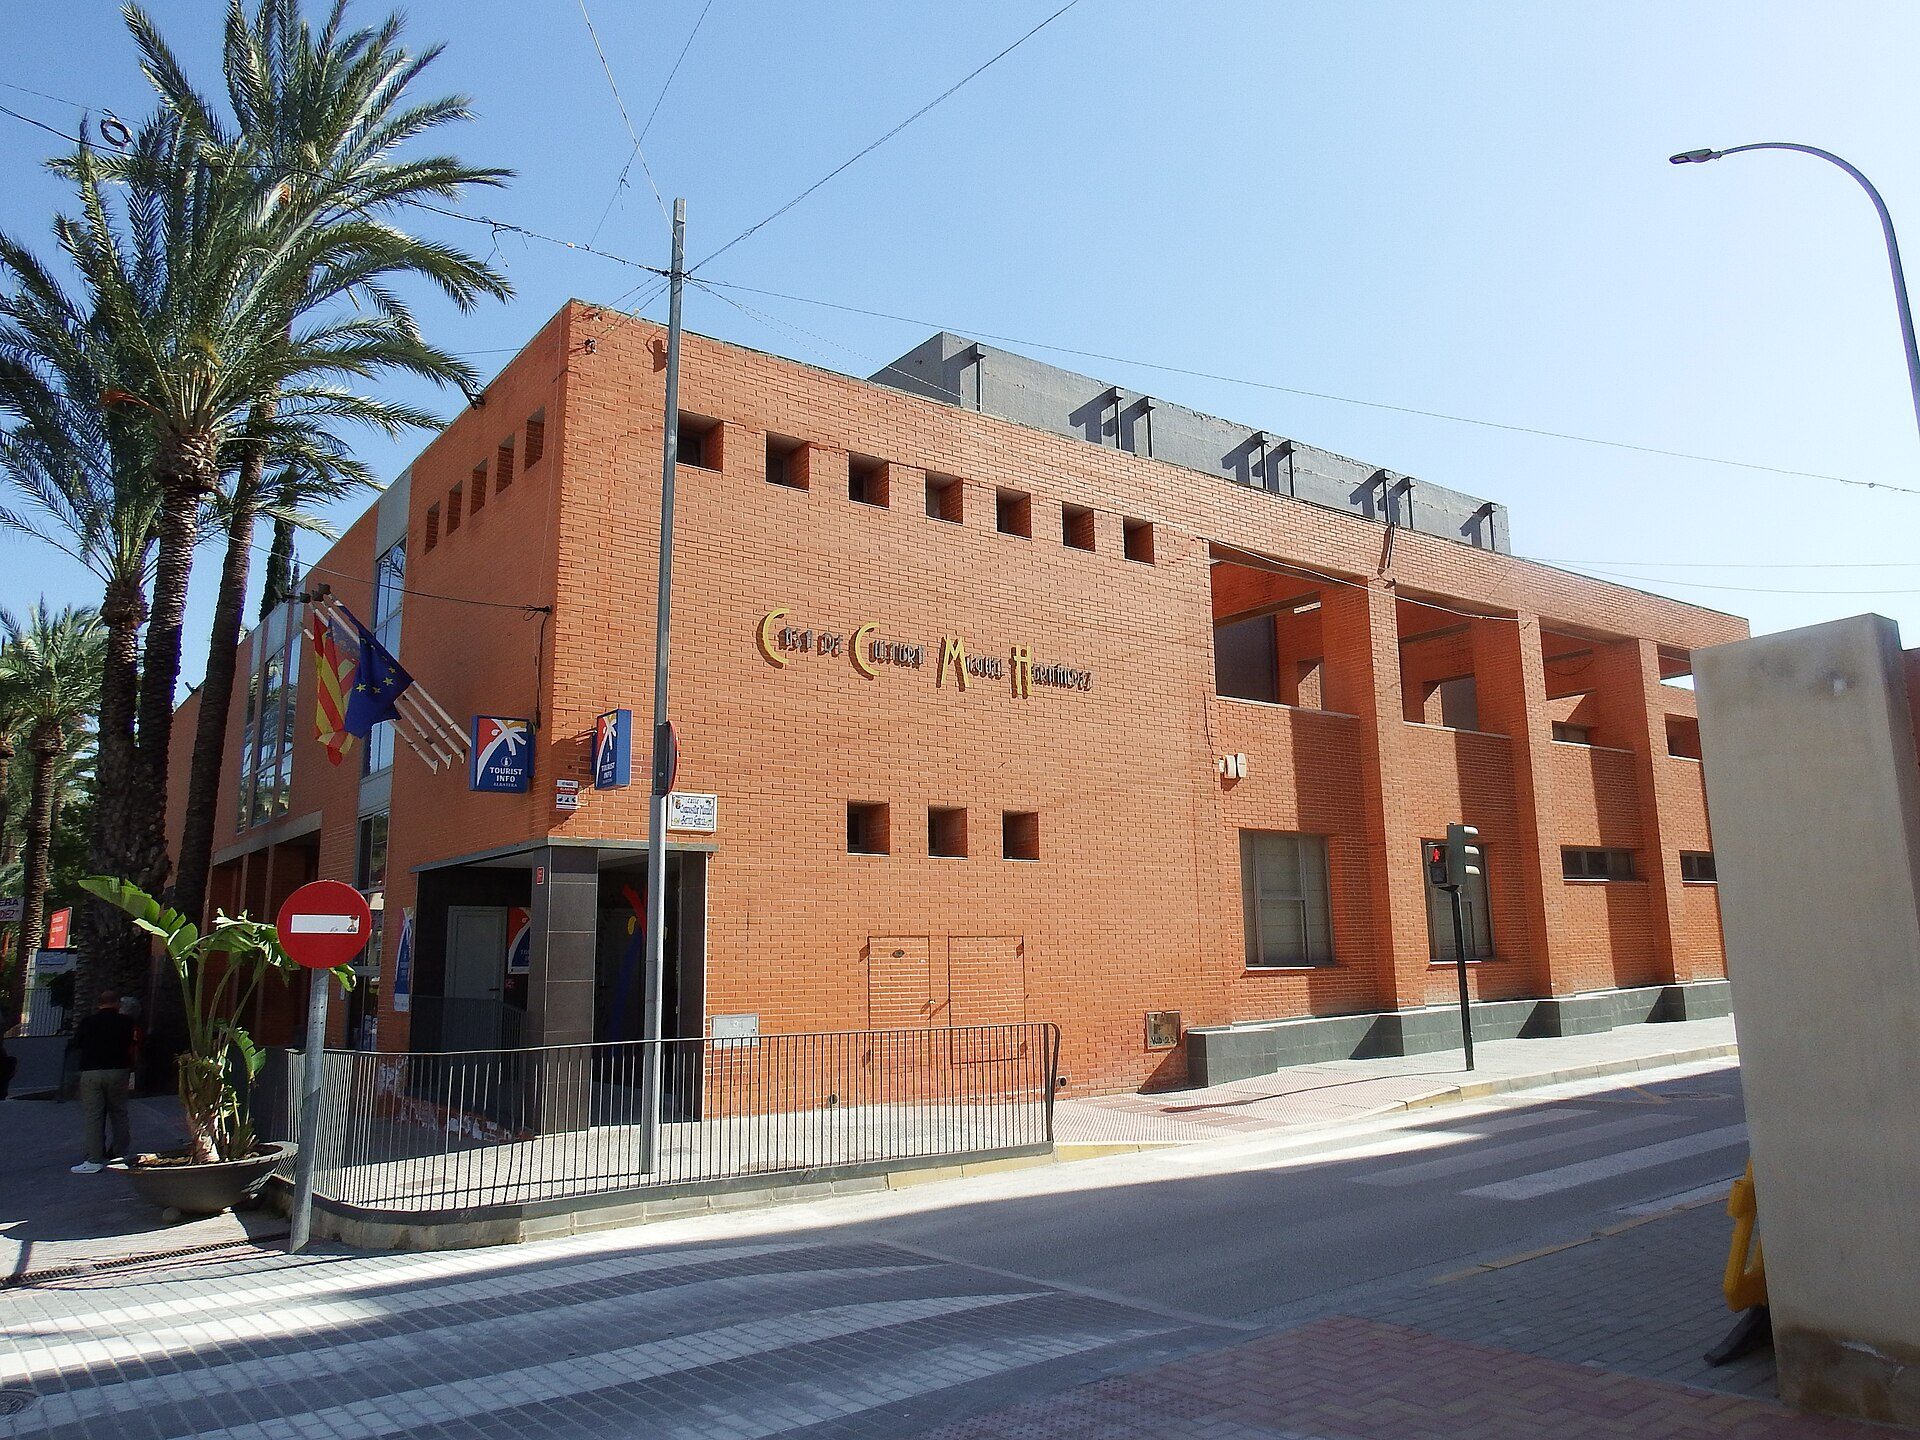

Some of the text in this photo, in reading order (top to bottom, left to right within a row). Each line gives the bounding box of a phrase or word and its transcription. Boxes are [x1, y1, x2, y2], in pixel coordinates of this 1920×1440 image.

[822, 632, 844, 654] DE
[489, 766, 523, 775] TOURIST
[601, 762, 616, 772] TOURIST
[496, 775, 516, 783] INFO
[603, 771, 612, 779] INFO
